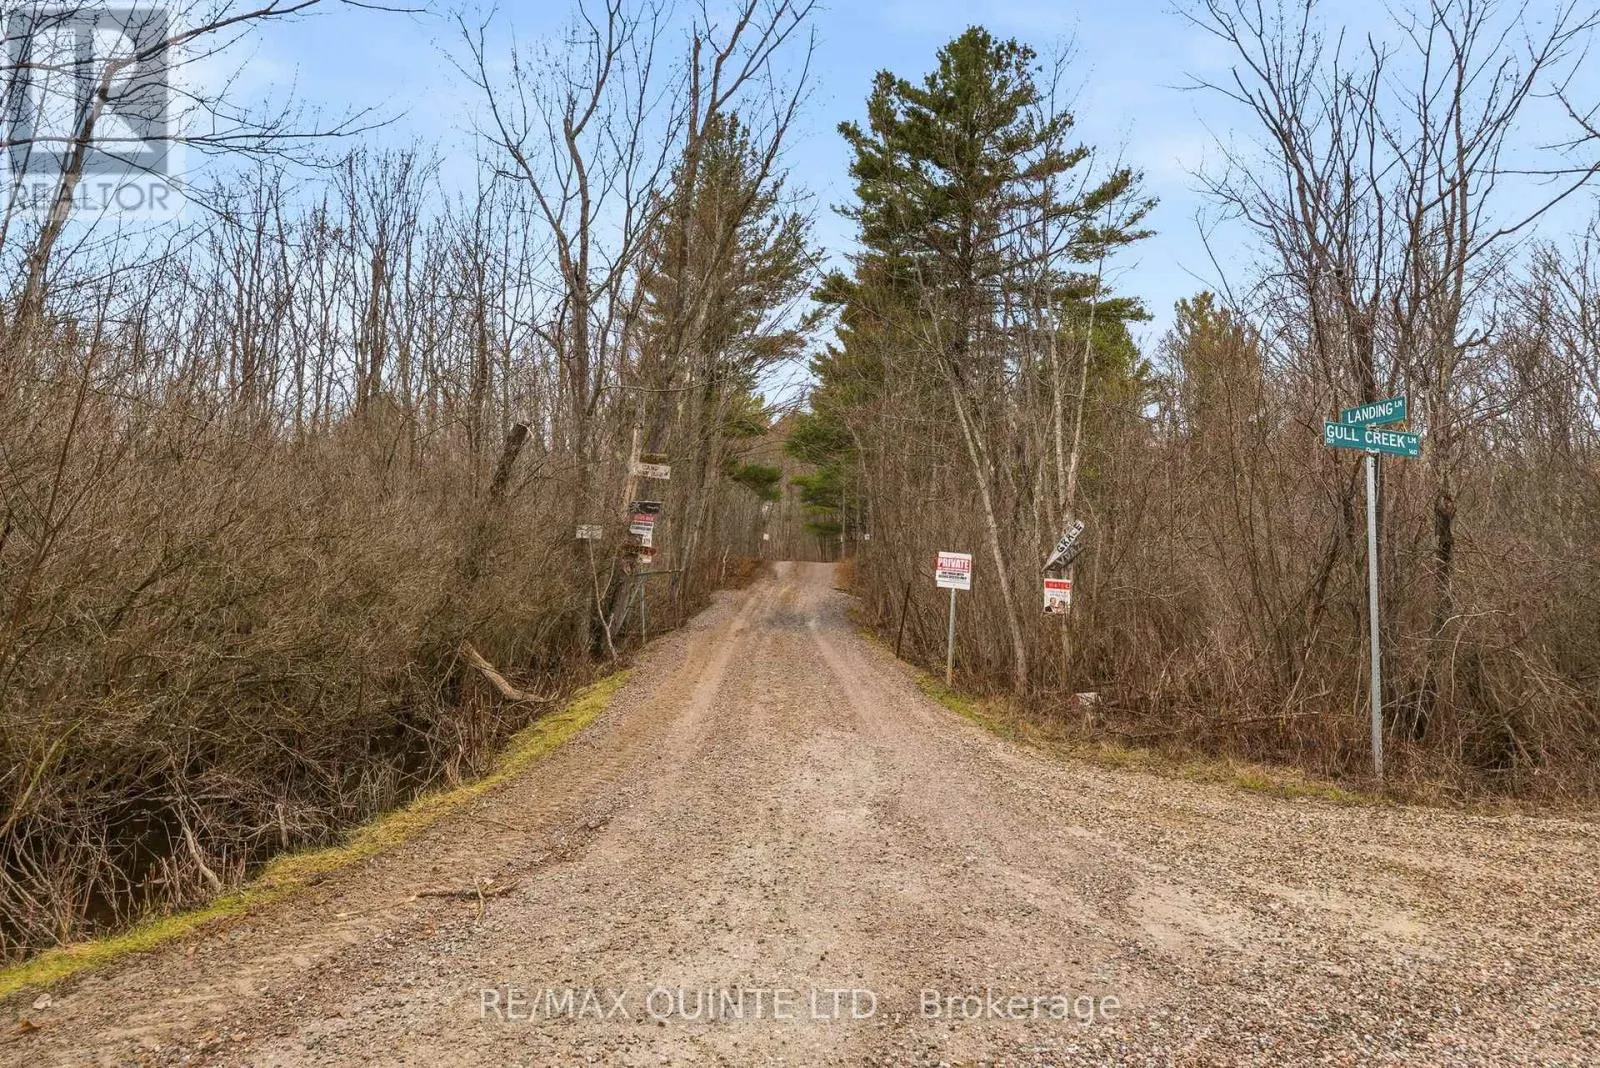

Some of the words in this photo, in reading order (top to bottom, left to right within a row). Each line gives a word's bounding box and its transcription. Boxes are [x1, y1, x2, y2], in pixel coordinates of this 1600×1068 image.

[1348, 402, 1393, 423] LANDING
[1326, 425, 1359, 442] GULL
[1365, 431, 1405, 448] CREEK
[938, 557, 969, 569] PRIVATE
